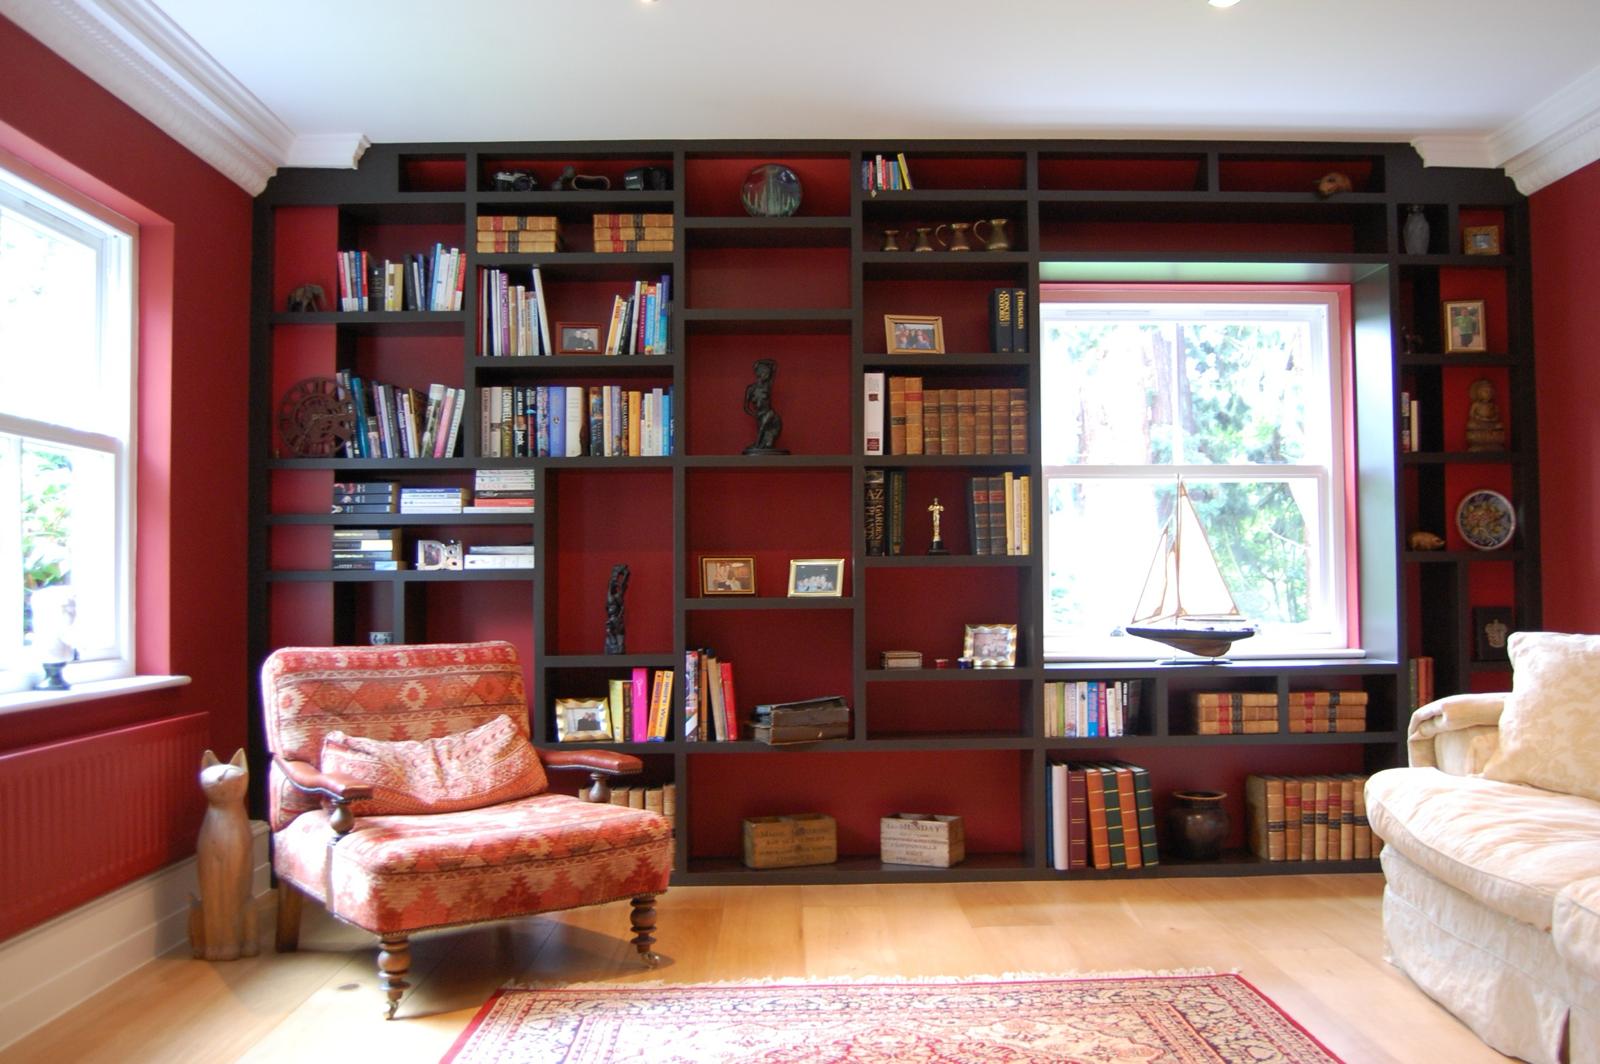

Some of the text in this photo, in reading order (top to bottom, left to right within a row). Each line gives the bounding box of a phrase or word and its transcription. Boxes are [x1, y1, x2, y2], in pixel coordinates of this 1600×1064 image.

[1017, 295, 1025, 330] THESAURUS
[502, 392, 512, 422] CORNWELL
[865, 506, 875, 540] PLANTS
[875, 505, 884, 540] GARDEN
